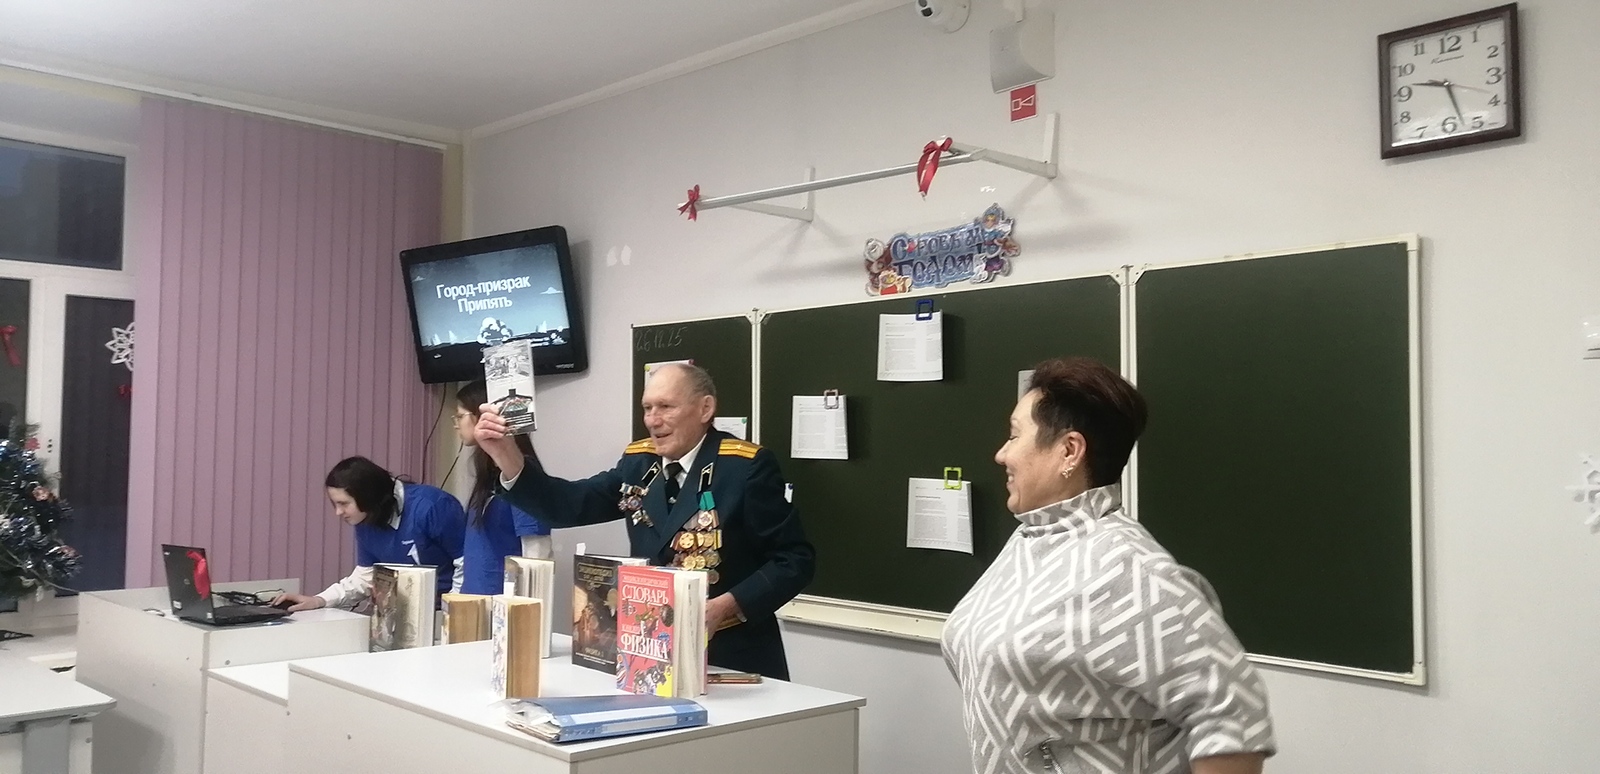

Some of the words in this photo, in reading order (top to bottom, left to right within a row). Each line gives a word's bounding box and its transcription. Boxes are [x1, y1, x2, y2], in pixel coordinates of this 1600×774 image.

[1414, 42, 1426, 56] 11
[1439, 35, 1462, 55] 12
[1487, 45, 1499, 59] 2
[1397, 63, 1416, 77] 10
[1486, 67, 1502, 85] 3
[1397, 85, 1413, 102] 9
[1488, 94, 1501, 107] 4
[1400, 111, 1411, 124] 8
[1441, 116, 1457, 134] 6
[1472, 116, 1485, 129] 5
[1416, 125, 1428, 138] 7
[436, 275, 531, 300] Город-призрак
[457, 296, 512, 315] Припять
[622, 584, 669, 604] СЛОВАРЬ
[621, 633, 668, 659] ФИЗИКА
